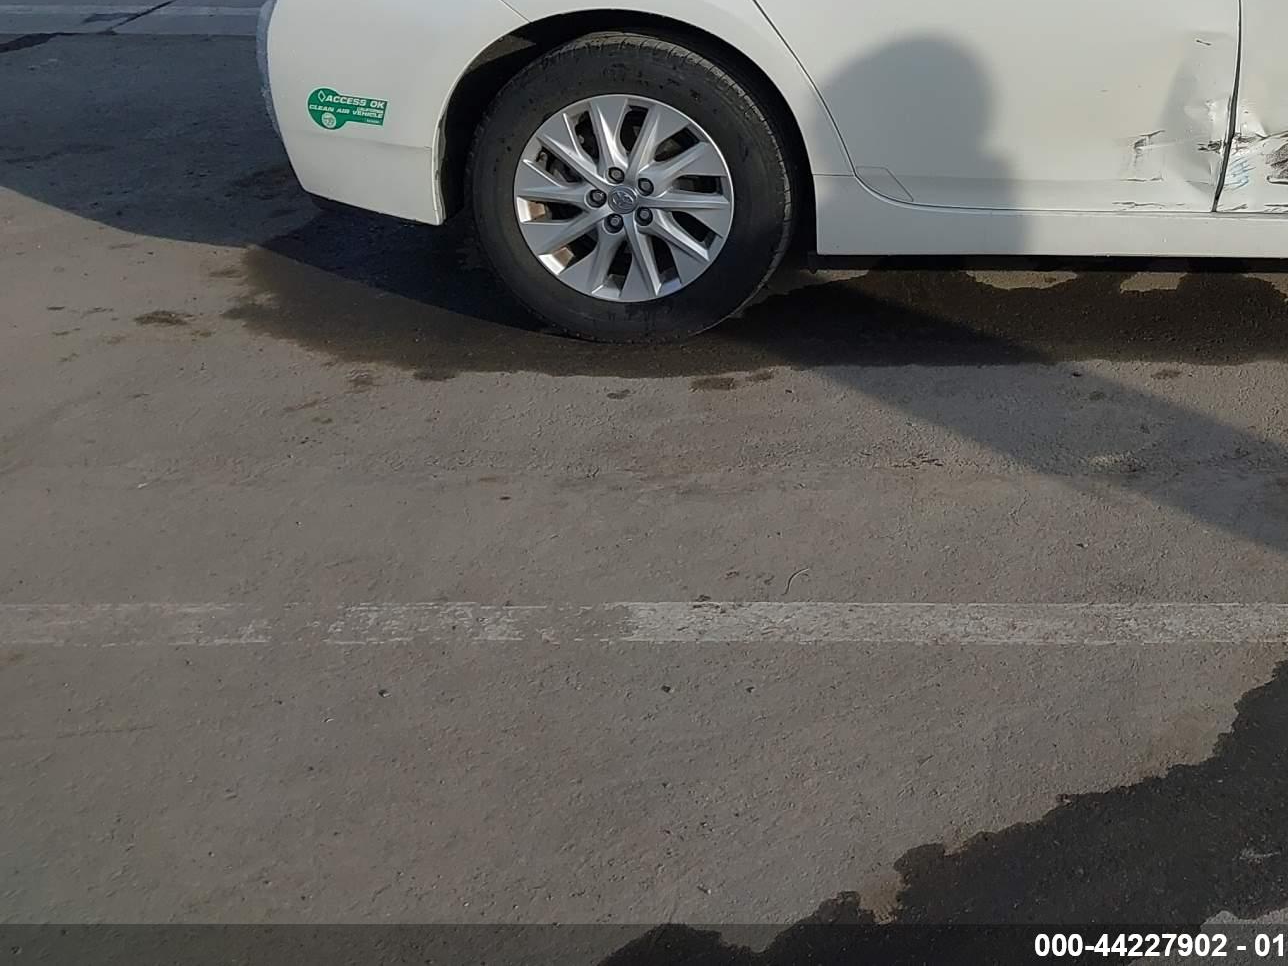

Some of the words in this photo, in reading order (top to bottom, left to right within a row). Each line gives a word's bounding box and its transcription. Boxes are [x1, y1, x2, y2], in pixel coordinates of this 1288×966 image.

[325, 95, 366, 106] ACCESS
[370, 100, 385, 109] OK
[309, 104, 334, 112] CLEAN
[352, 110, 384, 118] VEHICLE
